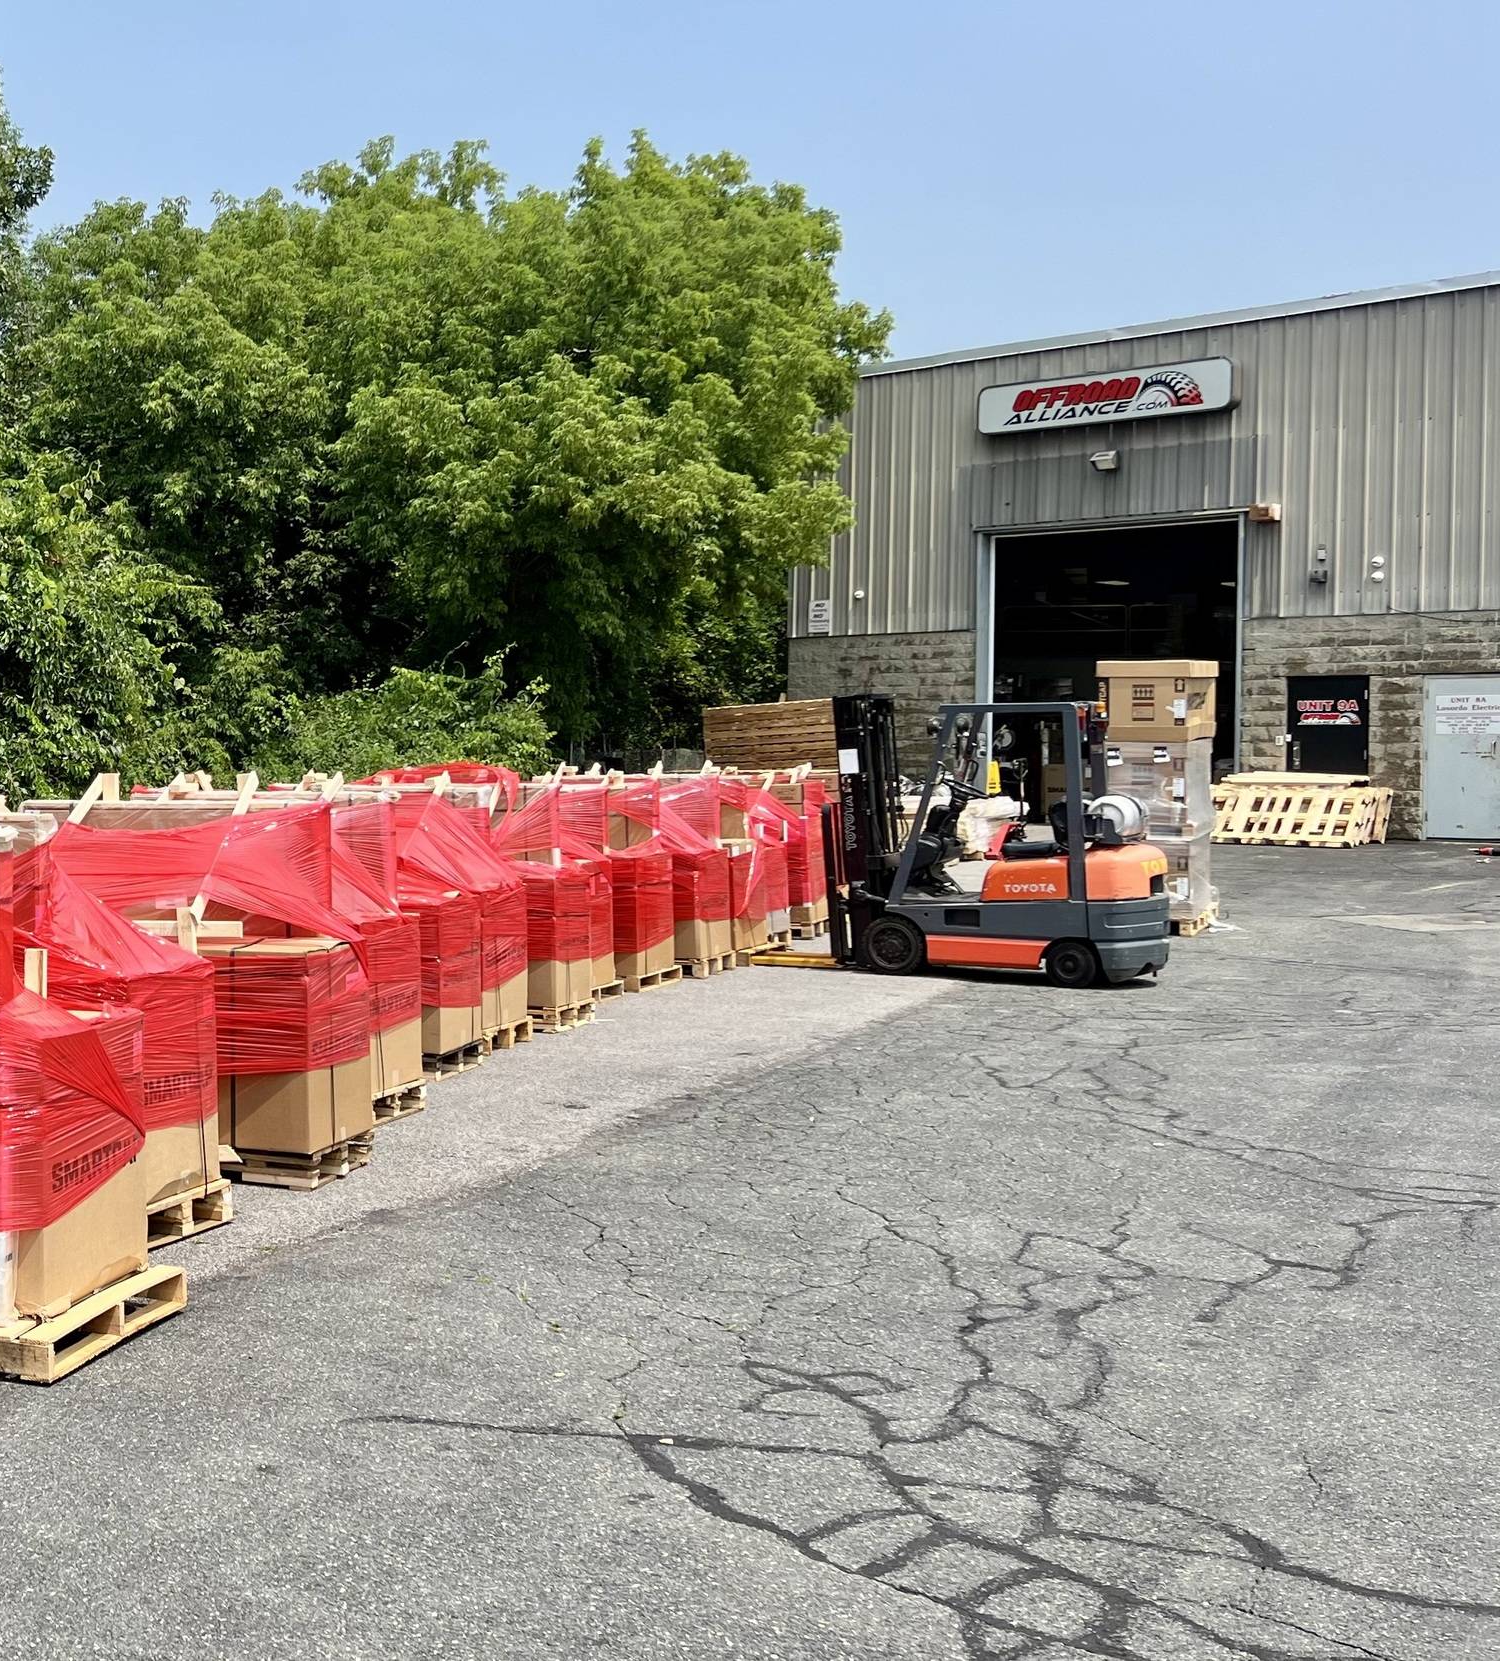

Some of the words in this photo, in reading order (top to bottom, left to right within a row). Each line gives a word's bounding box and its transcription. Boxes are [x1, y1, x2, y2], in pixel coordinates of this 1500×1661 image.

[1012, 377, 1141, 412] OFFROAD
[1003, 401, 1132, 426] ALLIANCE
[1297, 700, 1334, 711] UNIT
[1337, 699, 1359, 711] 9A
[844, 795, 858, 851] TOYOTA
[1004, 883, 1057, 893] TOYOTA
